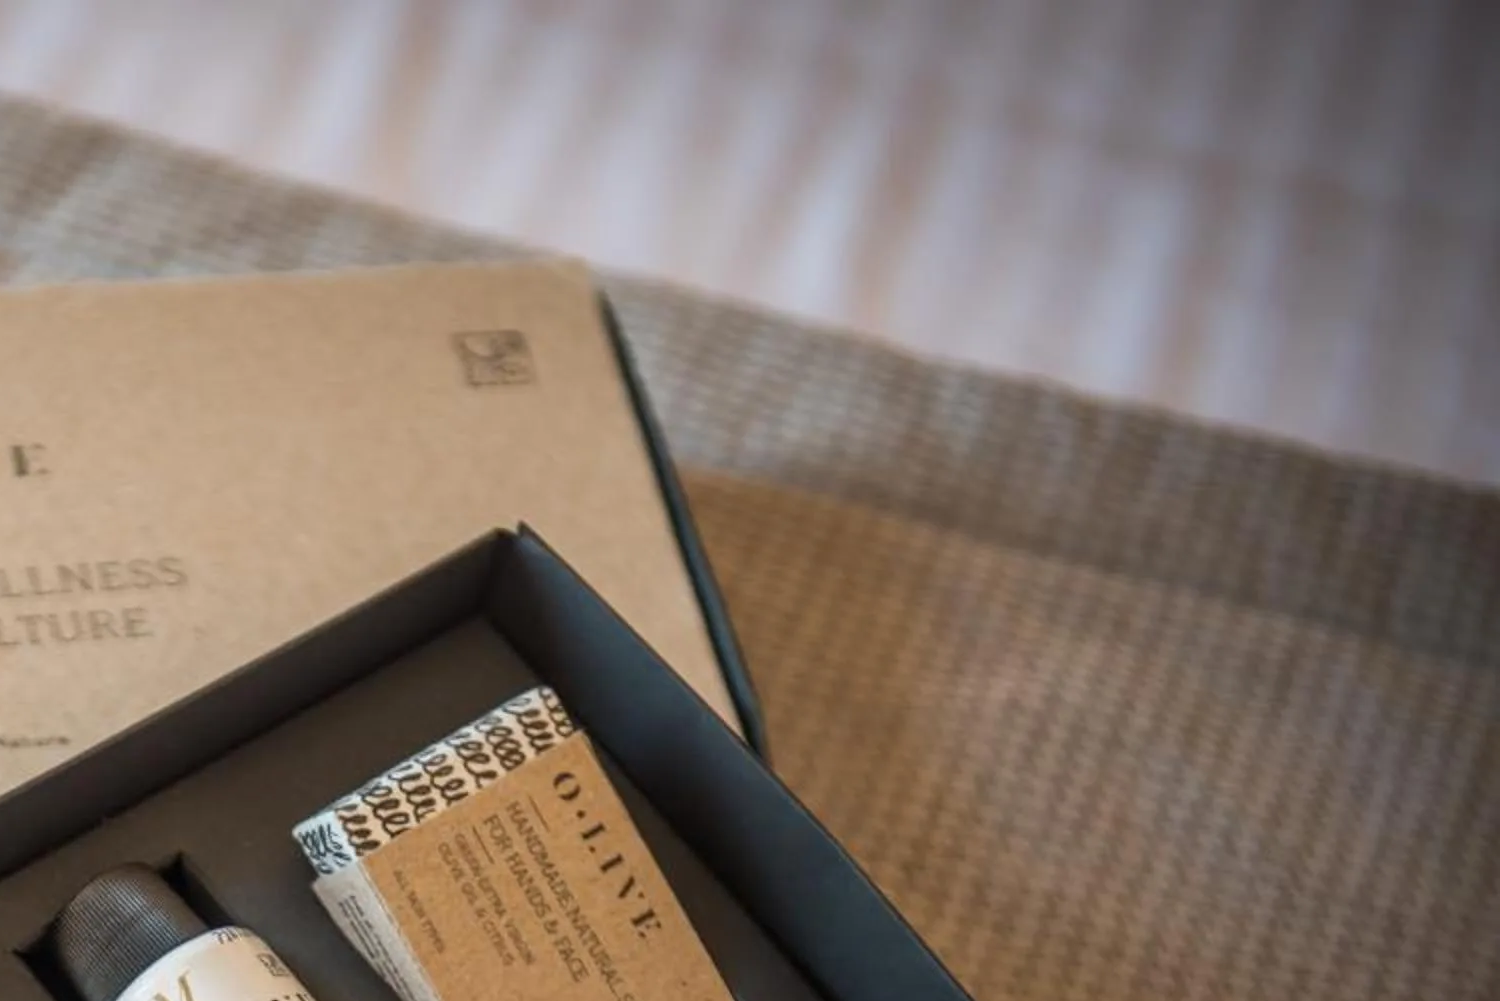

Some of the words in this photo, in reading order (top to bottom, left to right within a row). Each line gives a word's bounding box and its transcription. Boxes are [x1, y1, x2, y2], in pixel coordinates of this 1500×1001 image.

[483, 814, 513, 850] FOR
[504, 852, 551, 920] HANDS
[543, 915, 558, 937] &
[553, 932, 590, 984] FACE
[505, 800, 574, 909] HANDMADE
[569, 904, 621, 1000] NATURAL
